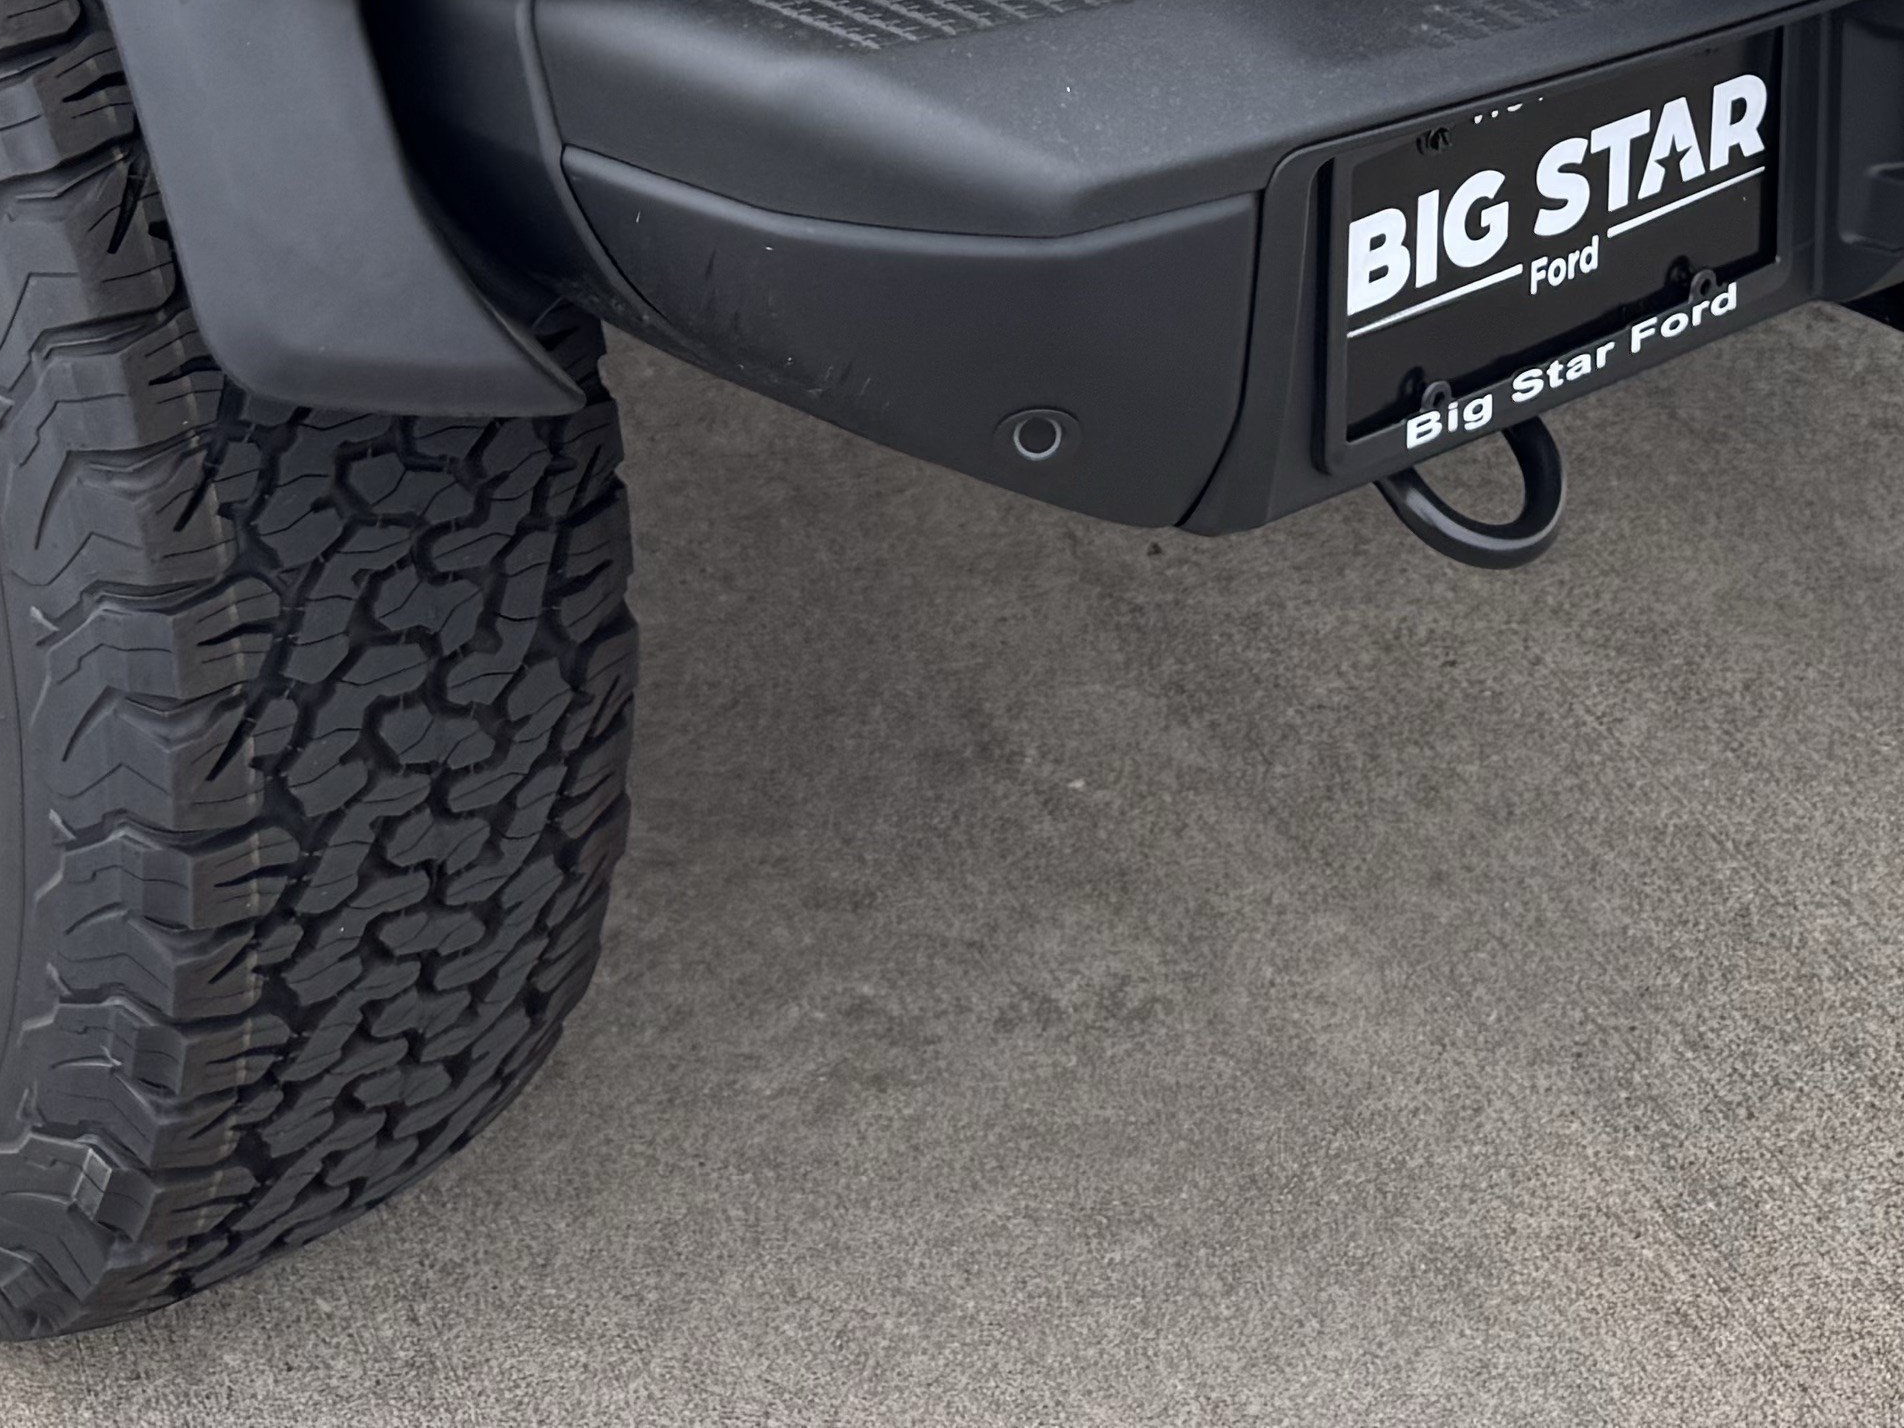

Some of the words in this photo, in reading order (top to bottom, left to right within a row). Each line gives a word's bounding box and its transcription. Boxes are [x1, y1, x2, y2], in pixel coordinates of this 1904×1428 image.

[1346, 169, 1510, 316] BIG
[1533, 73, 1767, 238] STAR
[1529, 234, 1600, 295] Ford
[1405, 392, 1494, 450] Big
[1511, 340, 1616, 403] Star
[1630, 281, 1738, 355] Ford
